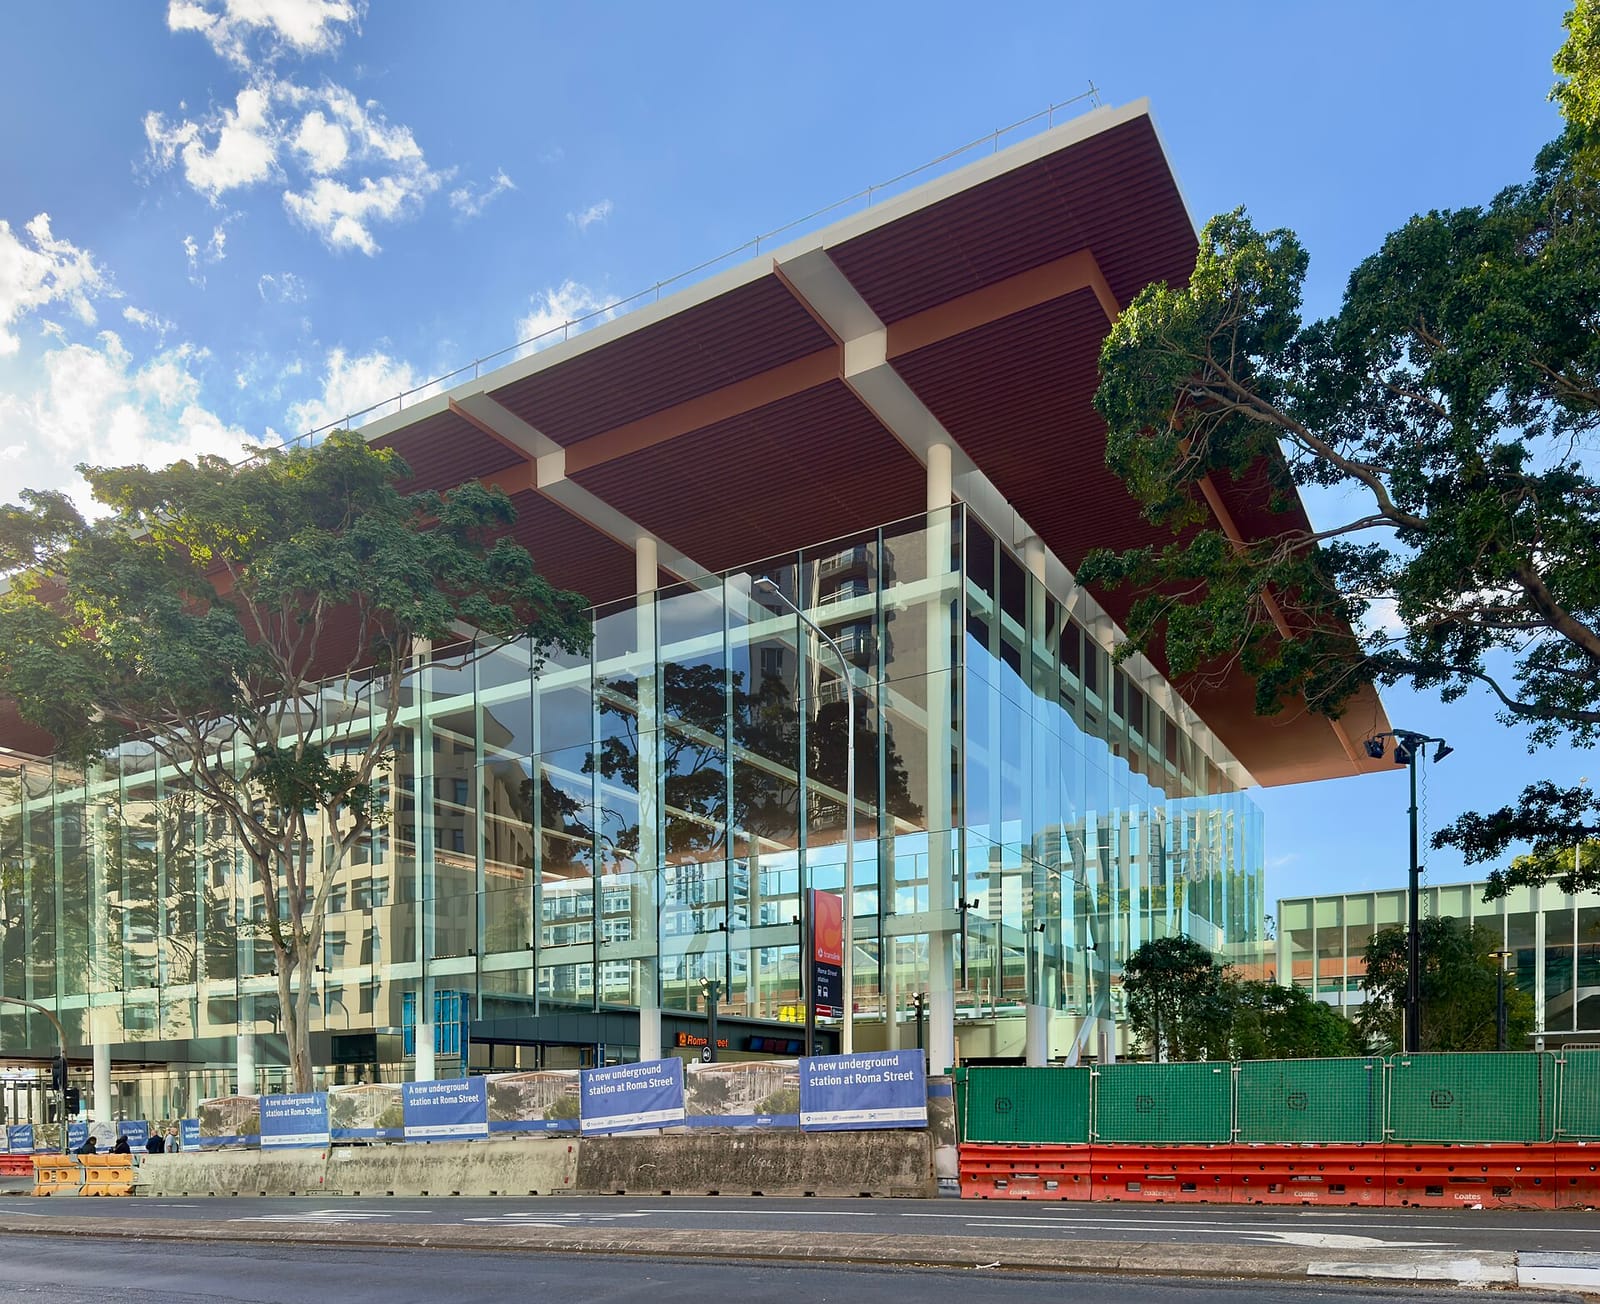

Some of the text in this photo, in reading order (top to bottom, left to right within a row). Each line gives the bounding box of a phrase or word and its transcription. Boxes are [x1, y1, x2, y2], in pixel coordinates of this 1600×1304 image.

[687, 1034, 708, 1046] Roma
[809, 1055, 899, 1072] A new underground
[588, 1064, 662, 1083] A new underground
[809, 1070, 914, 1087] station at Roma Street
[408, 1082, 469, 1095] A new underground
[588, 1076, 674, 1096] station at Roma Street
[265, 1099, 270, 1107] A
[281, 1096, 314, 1106] underground
[409, 1094, 480, 1106] station at Roma Street
[265, 1109, 283, 1117] station
[290, 1108, 305, 1116] Roma
